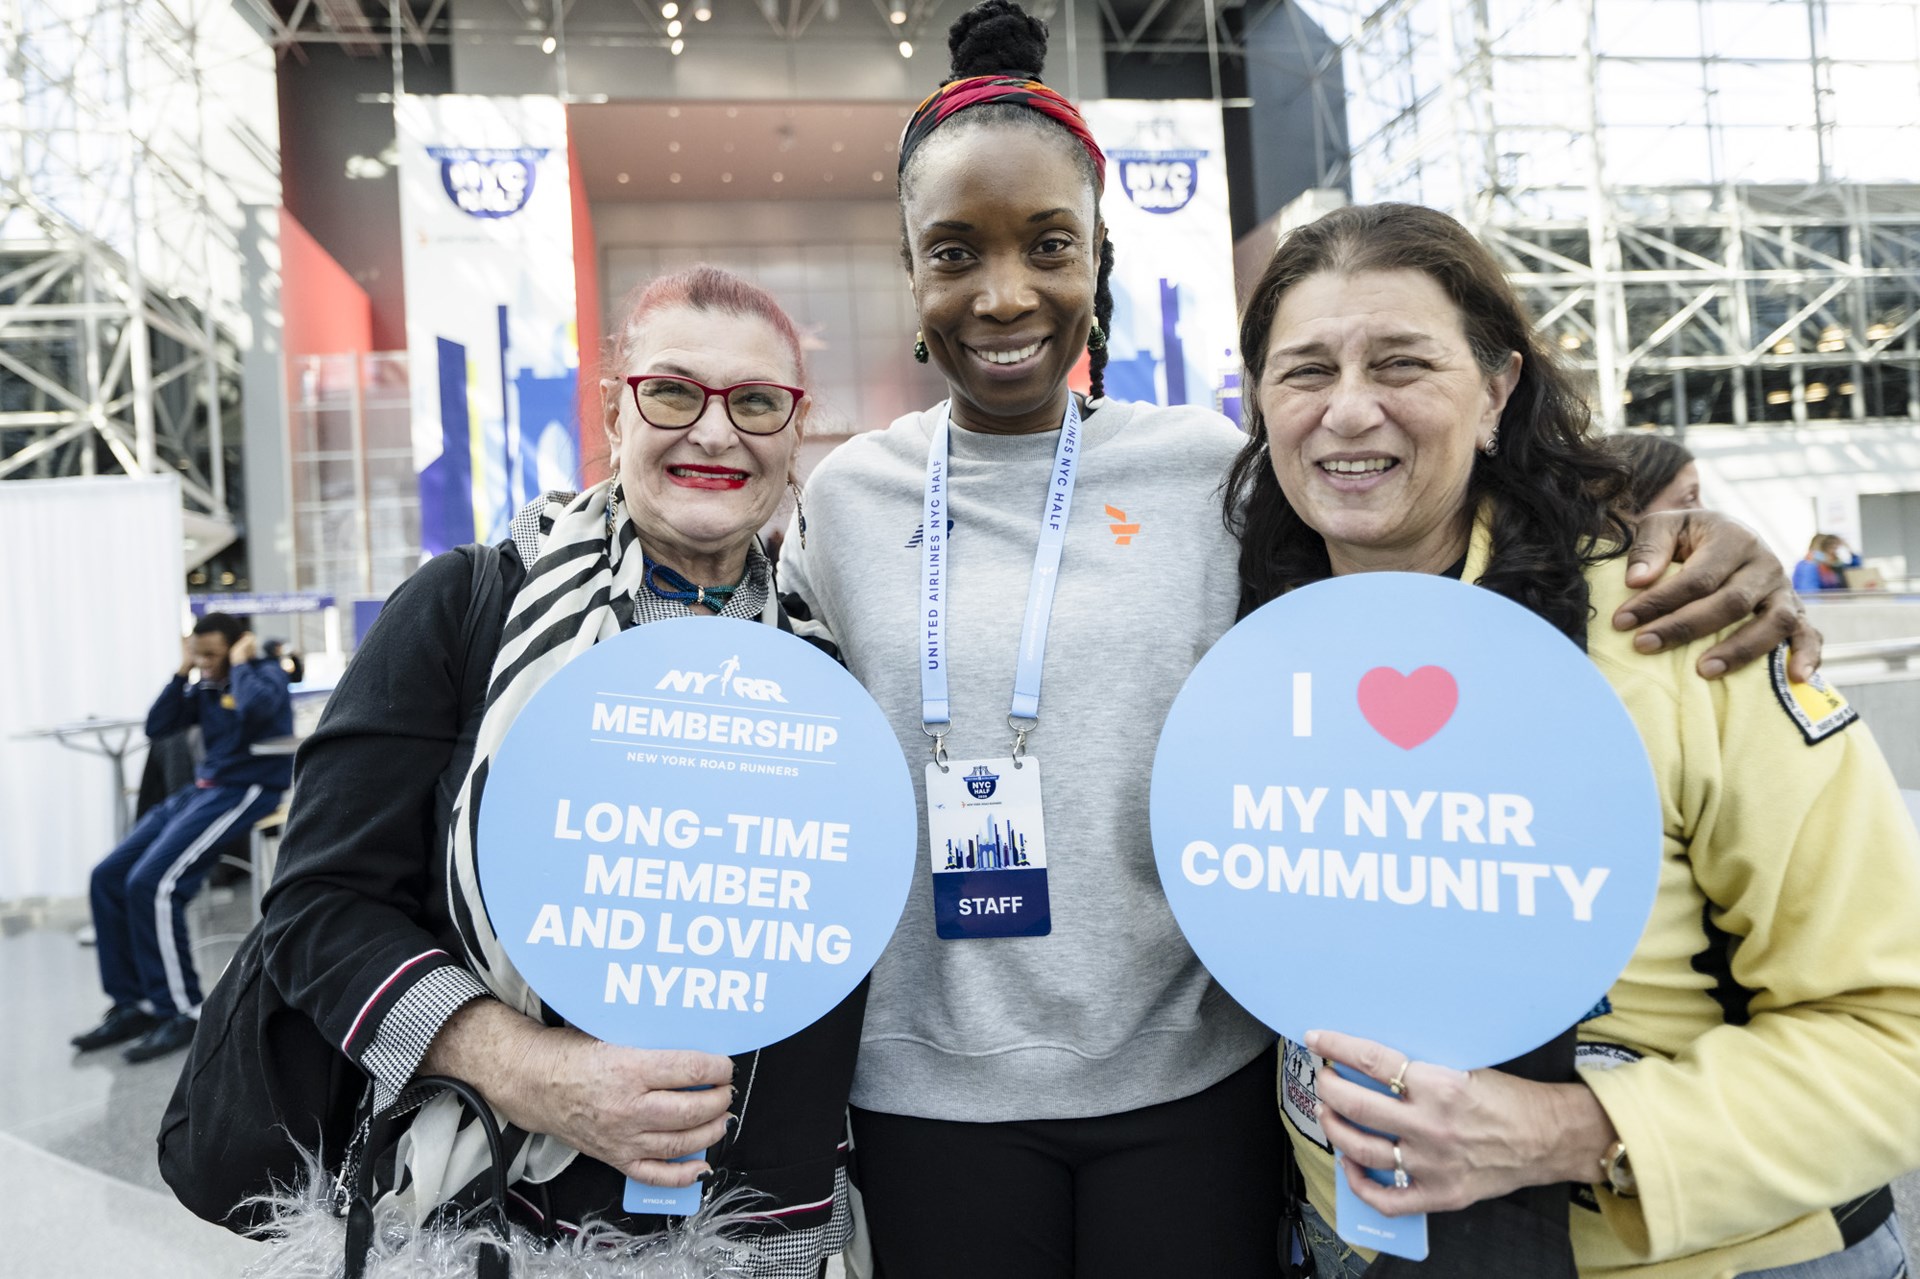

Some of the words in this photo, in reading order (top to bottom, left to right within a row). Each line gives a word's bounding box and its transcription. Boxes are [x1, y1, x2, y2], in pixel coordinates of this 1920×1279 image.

[1126, 161, 1192, 191] NYC
[931, 460, 942, 494] HALF
[1056, 457, 1071, 487] NYC
[931, 498, 941, 528] NYC
[1049, 492, 1063, 531] HALF
[929, 534, 941, 602] AIRLINES
[928, 608, 939, 670] UNITED
[591, 702, 839, 753] MEMBERSHIP
[1292, 672, 1312, 737] I
[627, 751, 658, 763] NEW
[661, 755, 696, 768] YORK
[700, 758, 737, 772] ROAD
[740, 762, 800, 778] RUNNERS
[554, 799, 850, 862] LONG-TIME
[1233, 785, 1330, 833] MY
[1344, 788, 1536, 848] NYRR
[583, 854, 811, 911] MEMBER
[959, 896, 1023, 916] STAFF
[1181, 841, 1611, 922] COMMUNITY
[526, 904, 646, 950] AND
[656, 912, 852, 965] LOVING
[603, 962, 768, 1013] NYRR!
